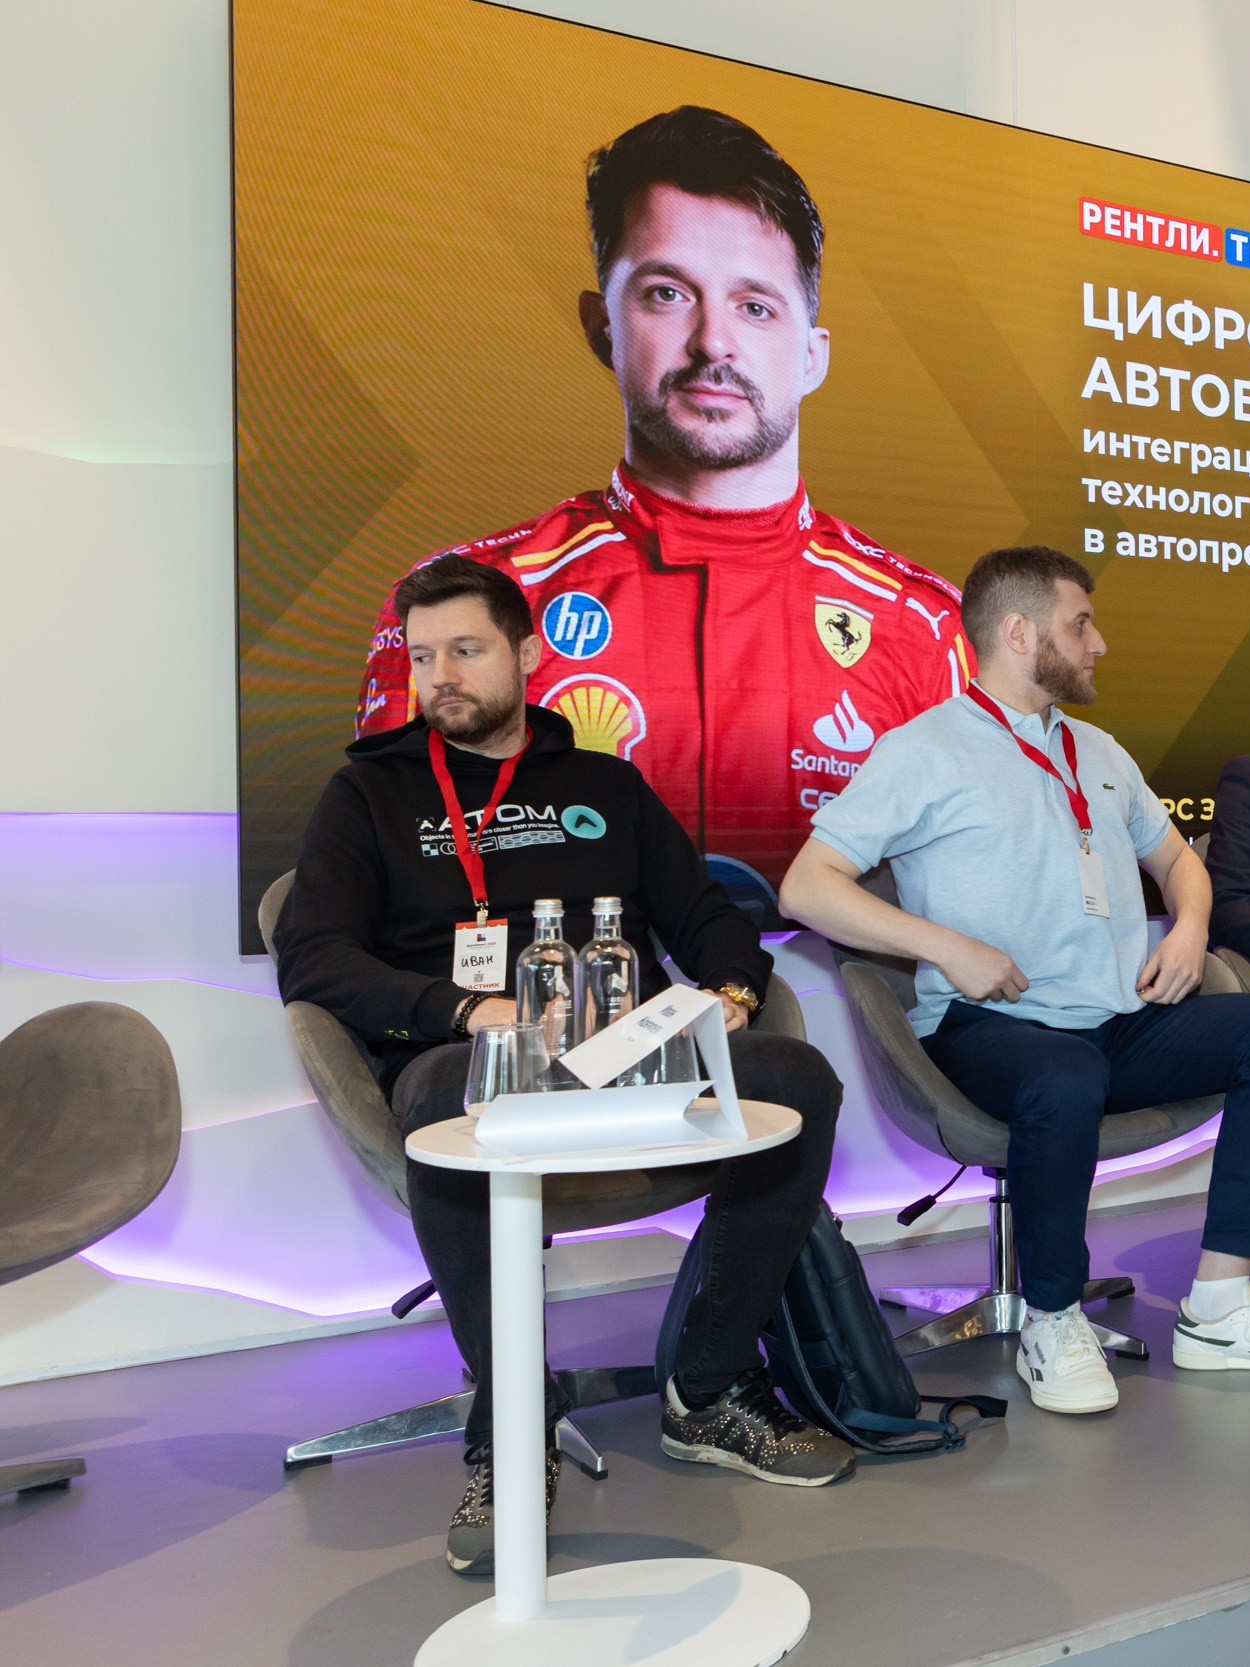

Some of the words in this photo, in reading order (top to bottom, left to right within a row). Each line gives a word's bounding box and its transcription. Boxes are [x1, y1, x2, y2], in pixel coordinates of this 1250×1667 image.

[1082, 202, 1219, 257] РЕНТЛИ.
[1084, 528, 1105, 553] в
[553, 594, 602, 657] hp
[790, 748, 861, 777] Santan
[461, 955, 494, 968] ИВАН
